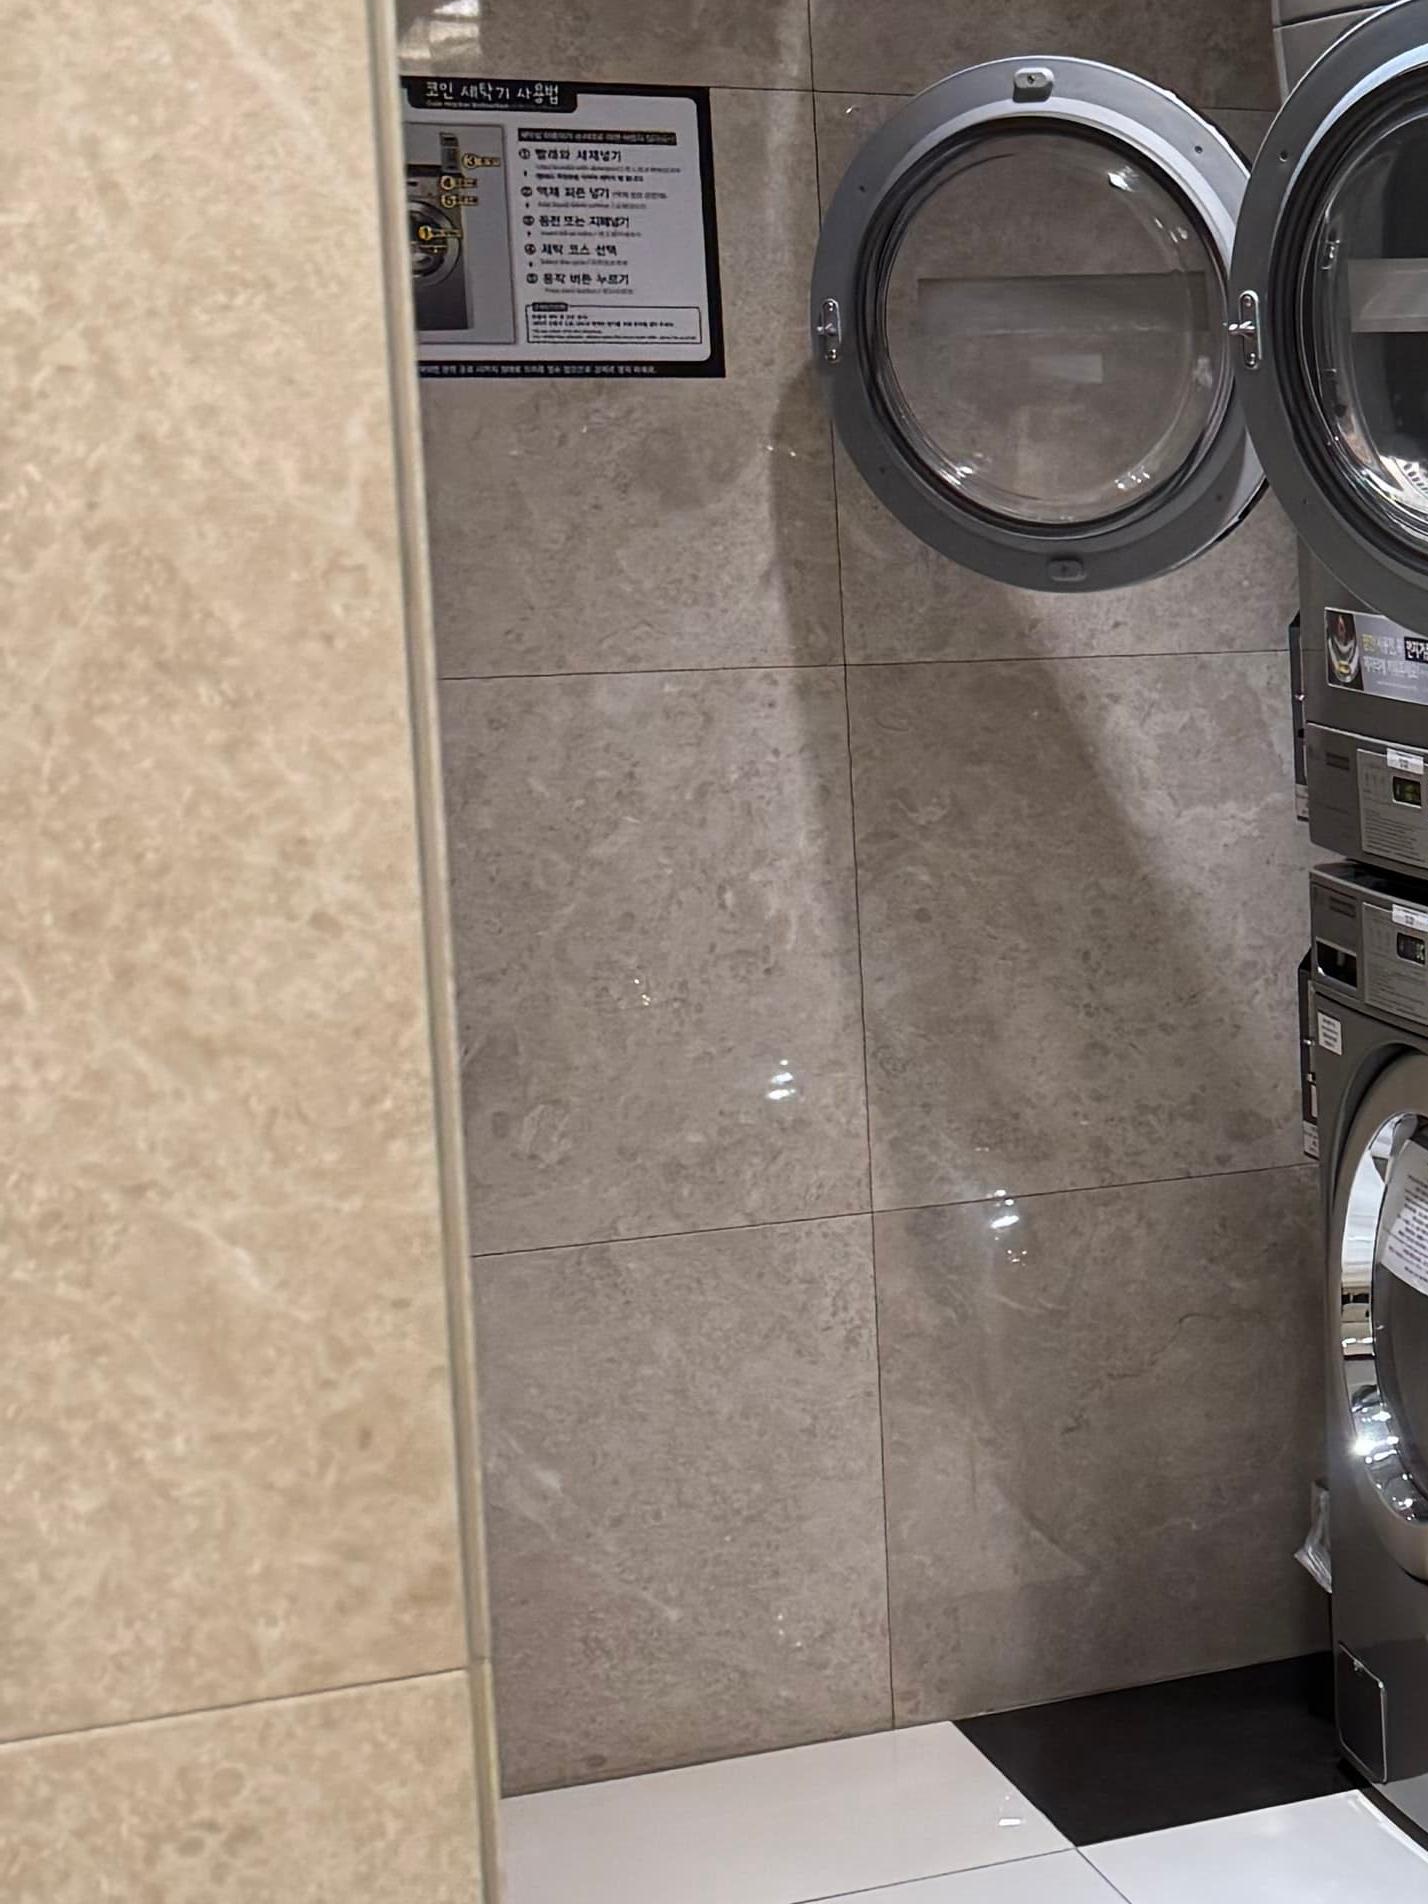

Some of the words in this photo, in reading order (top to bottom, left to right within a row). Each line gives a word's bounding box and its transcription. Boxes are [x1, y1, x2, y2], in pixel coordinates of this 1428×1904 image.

[426, 81, 453, 99] 코인
[461, 84, 510, 101] 세탁기
[517, 84, 559, 104] 사용법
[541, 244, 565, 256] 세탁
